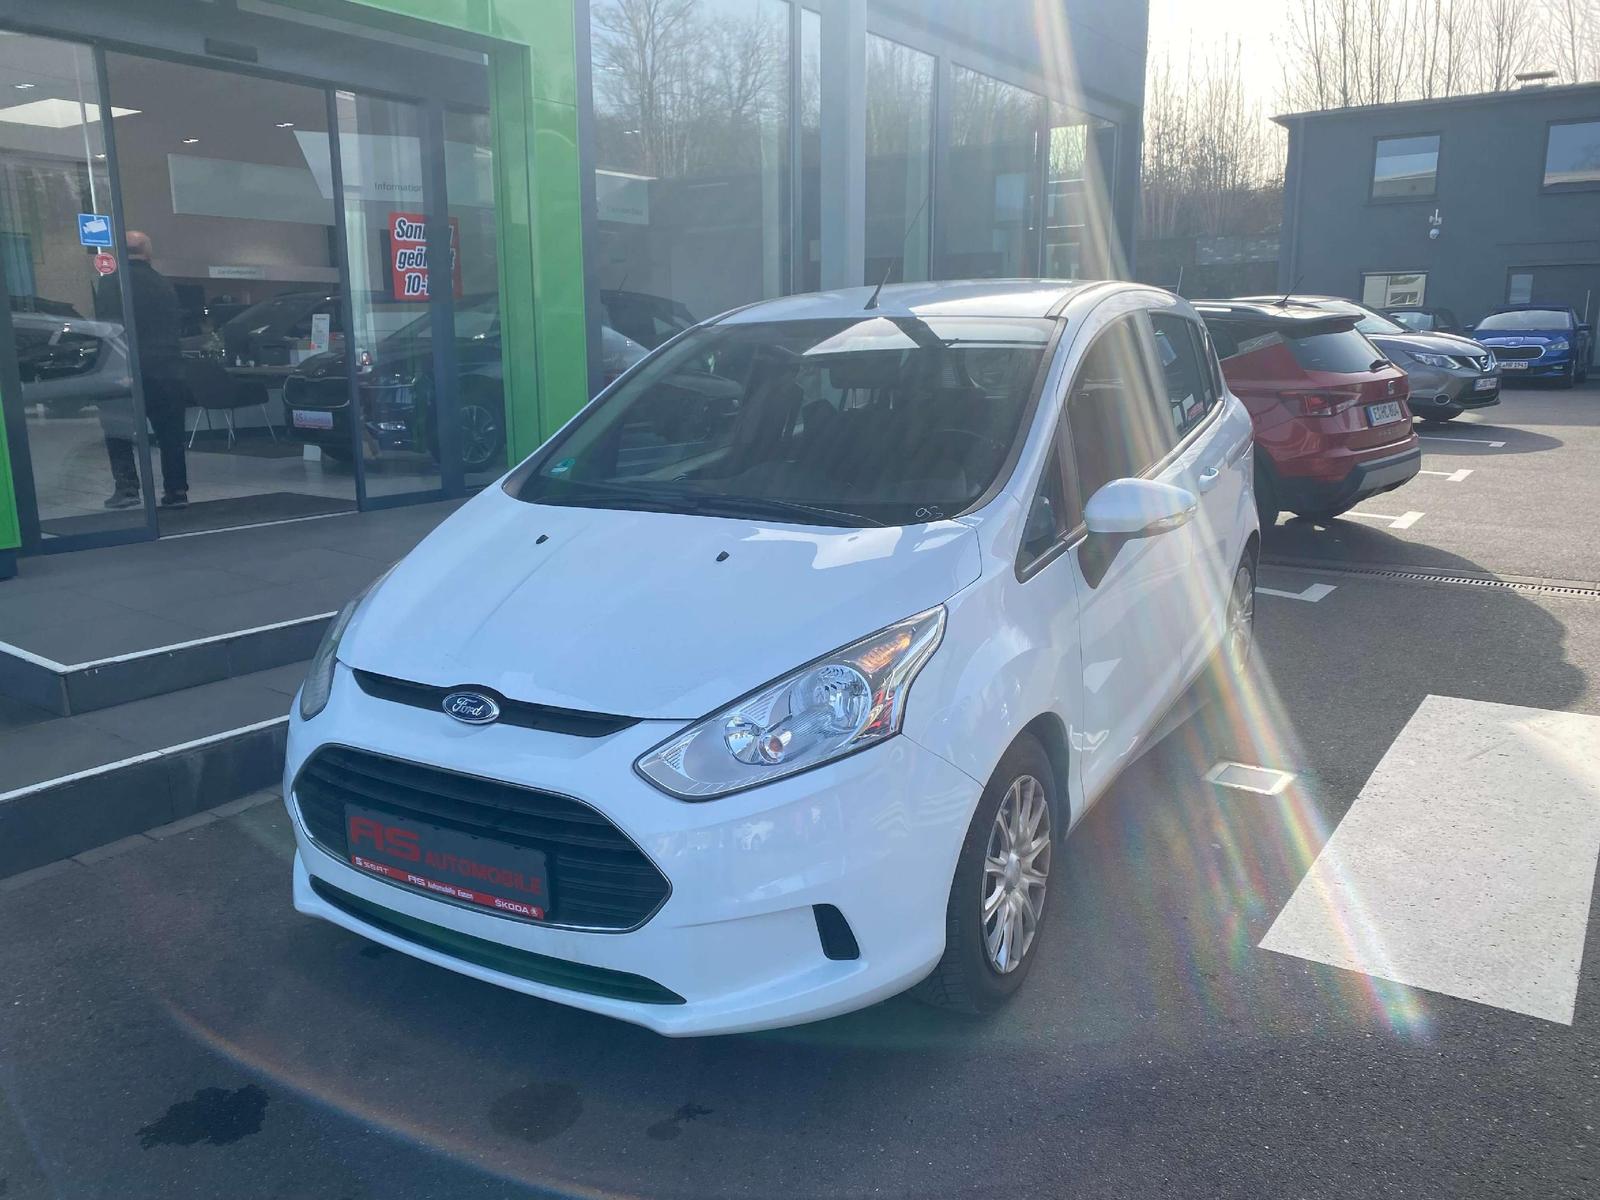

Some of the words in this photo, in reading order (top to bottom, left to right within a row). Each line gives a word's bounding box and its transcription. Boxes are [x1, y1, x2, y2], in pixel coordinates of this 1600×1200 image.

[452, 697, 484, 716] Ford
[350, 815, 421, 862] AS
[363, 861, 389, 875] SEAT
[494, 898, 530, 915] ŠKODA
[425, 852, 542, 895] AUTOMOBILE
